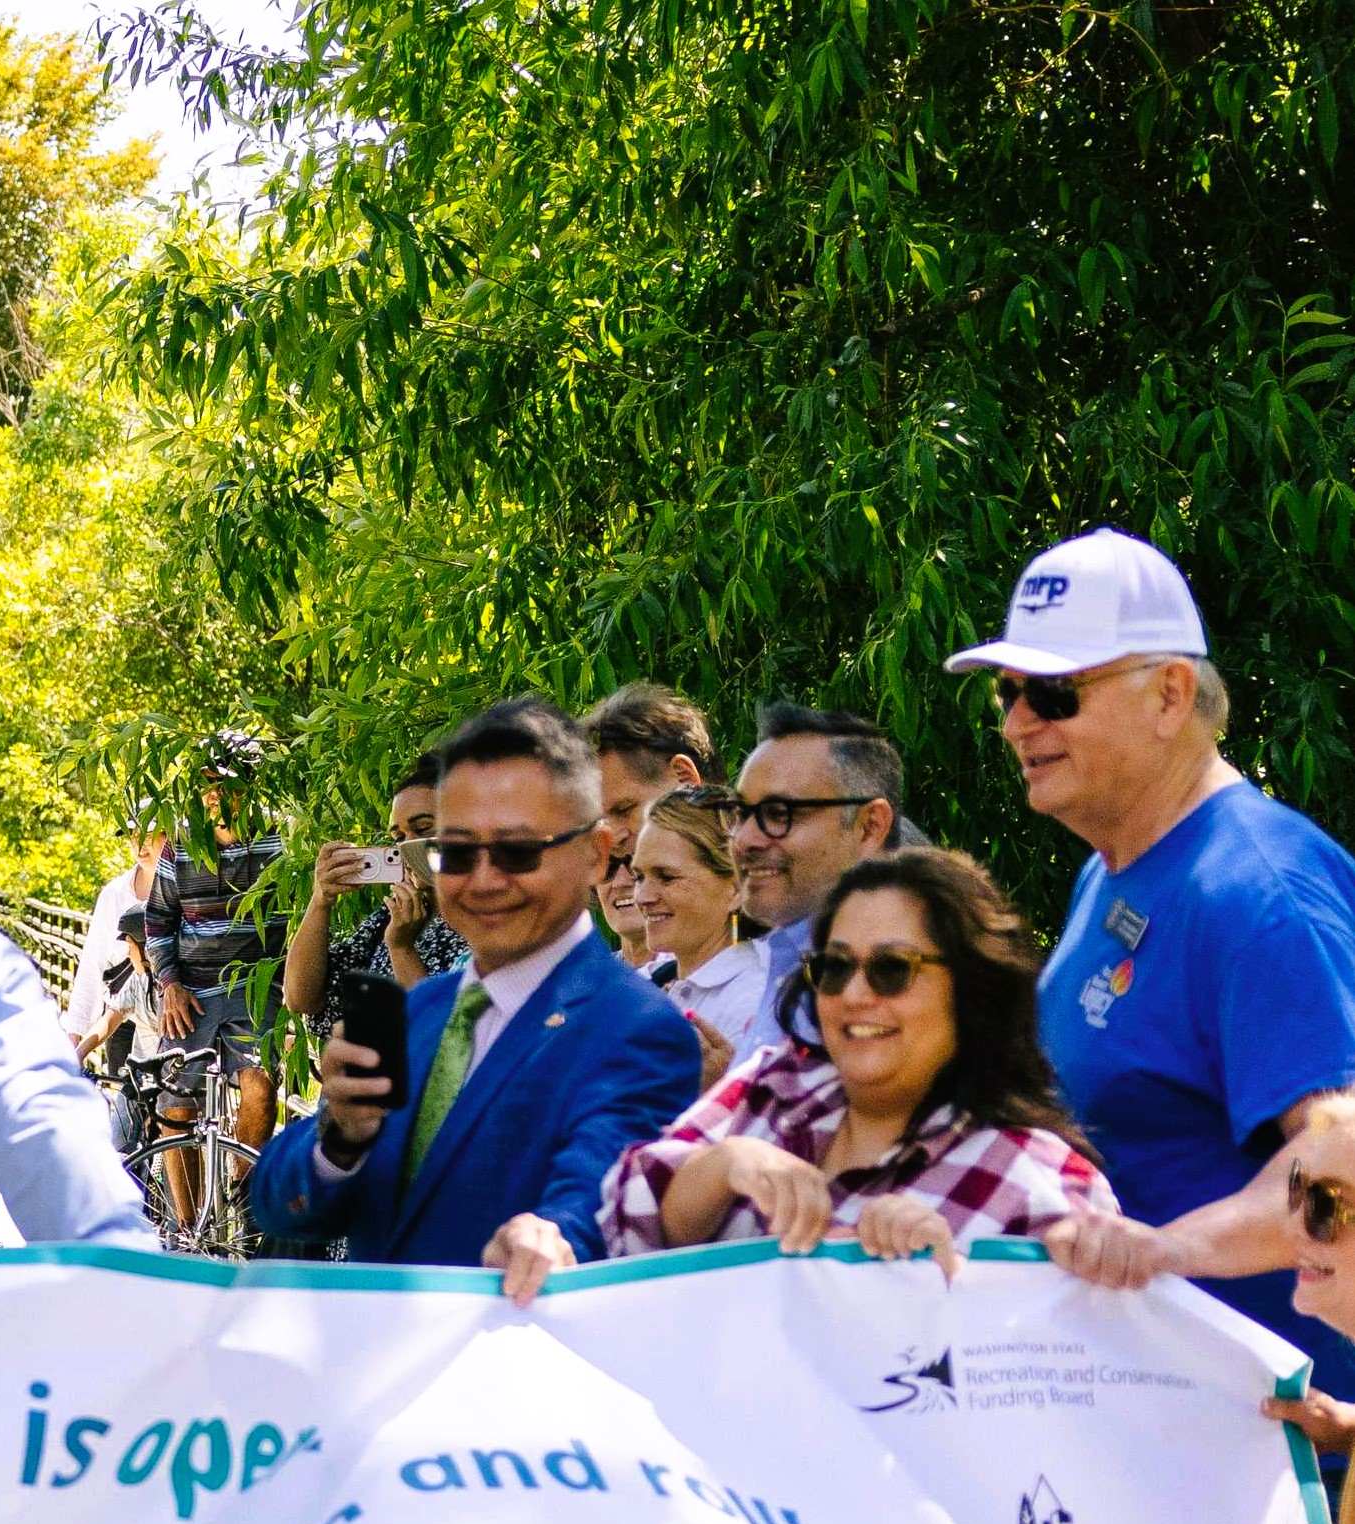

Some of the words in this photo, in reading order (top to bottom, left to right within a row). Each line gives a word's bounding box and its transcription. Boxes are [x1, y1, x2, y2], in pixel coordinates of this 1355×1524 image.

[1063, 1365, 1095, 1384] and
[20, 1380, 112, 1488] is
[398, 1437, 610, 1493] and
